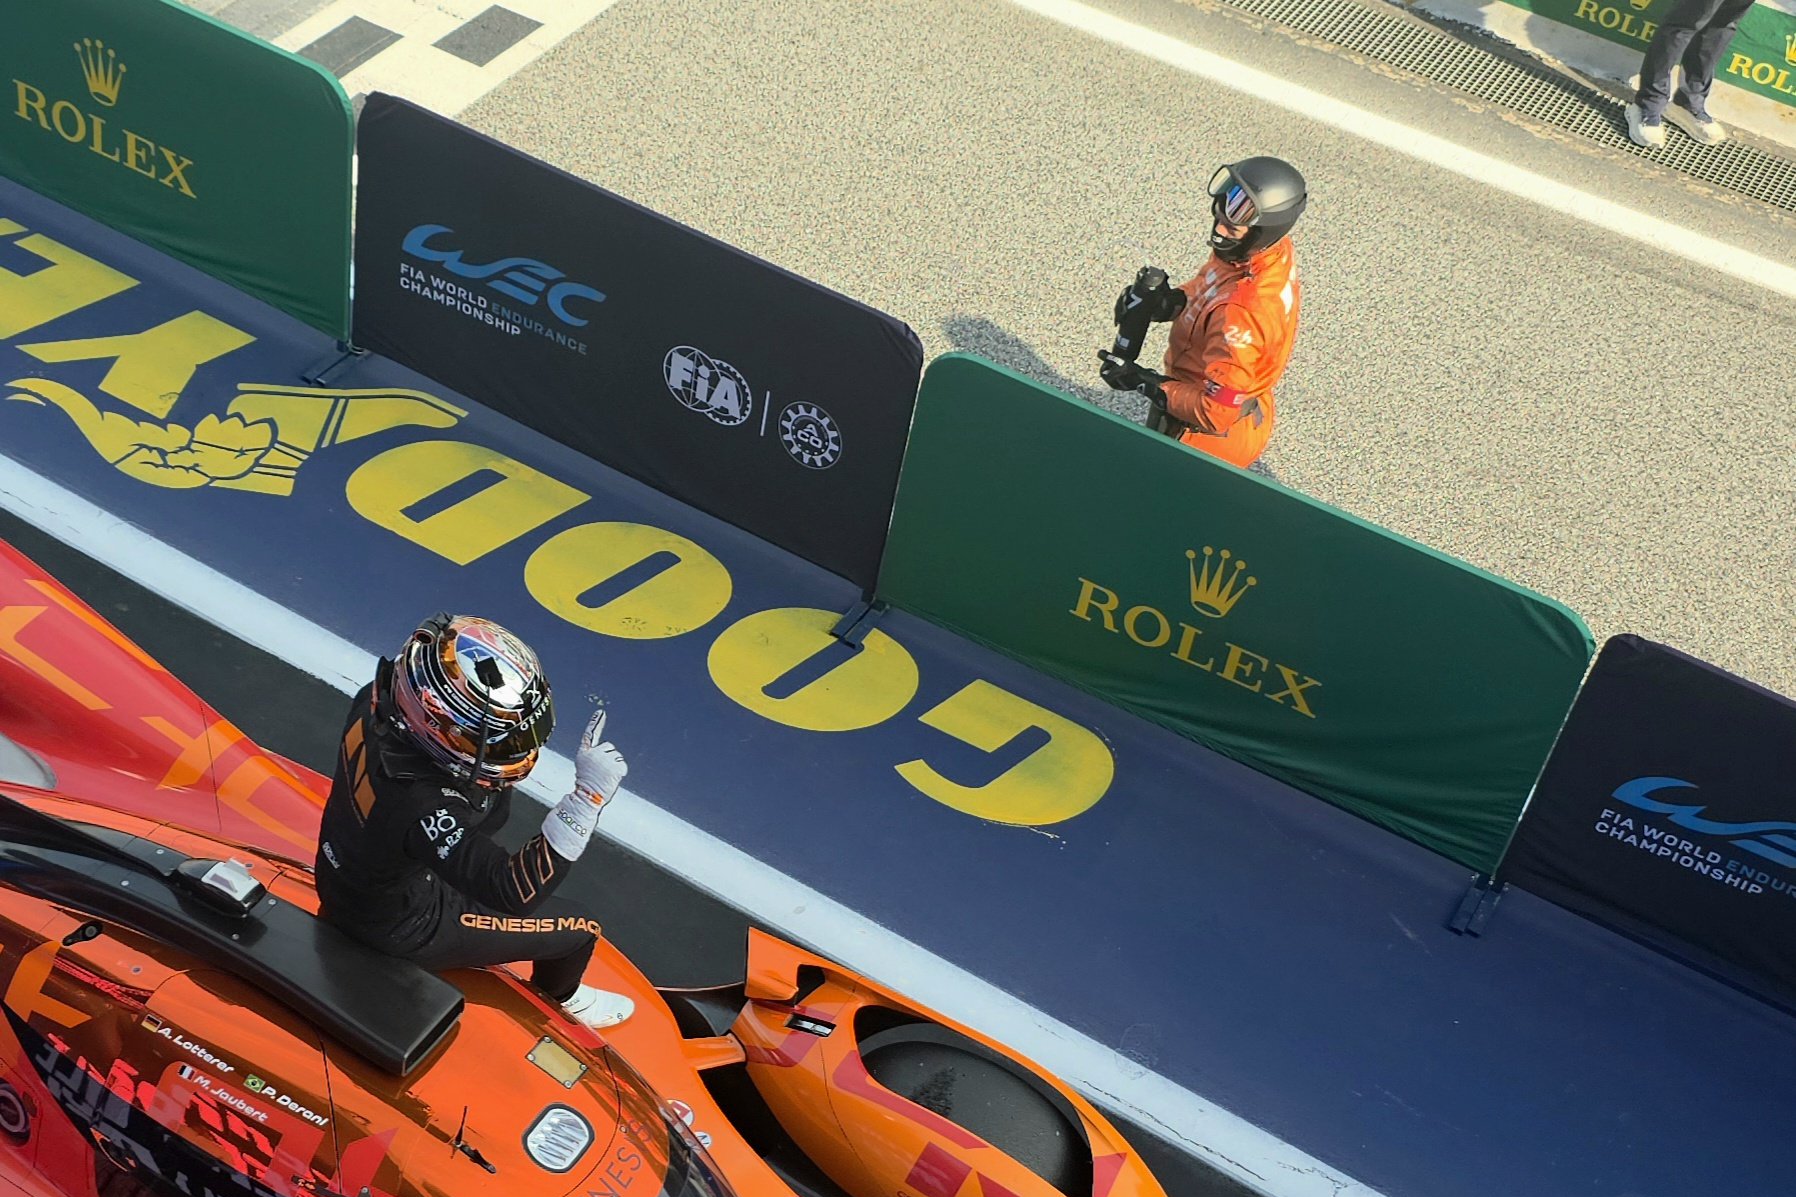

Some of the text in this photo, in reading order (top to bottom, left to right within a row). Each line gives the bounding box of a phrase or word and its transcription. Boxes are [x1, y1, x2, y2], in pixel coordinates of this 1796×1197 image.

[1574, 0, 1660, 42] ROLE
[1726, 52, 1796, 96] ROL
[12, 79, 197, 198] ROLEX
[402, 223, 607, 327] WEC
[400, 277, 521, 335] CHAMPIONSHIP
[400, 263, 588, 356] FIA WORLD ENDURANCE
[1069, 577, 1323, 719] ROLEX
[1600, 808, 1634, 830] FIA
[1643, 824, 1721, 864] WORLD
[1611, 776, 1796, 868] WE
[1595, 821, 1763, 894] CHAMPIONSHIP
[460, 913, 554, 933] GENESIS
[157, 1027, 235, 1073] A. Lotterer
[193, 1075, 268, 1122] M. Jaubert
[261, 1086, 276, 1100] P.
